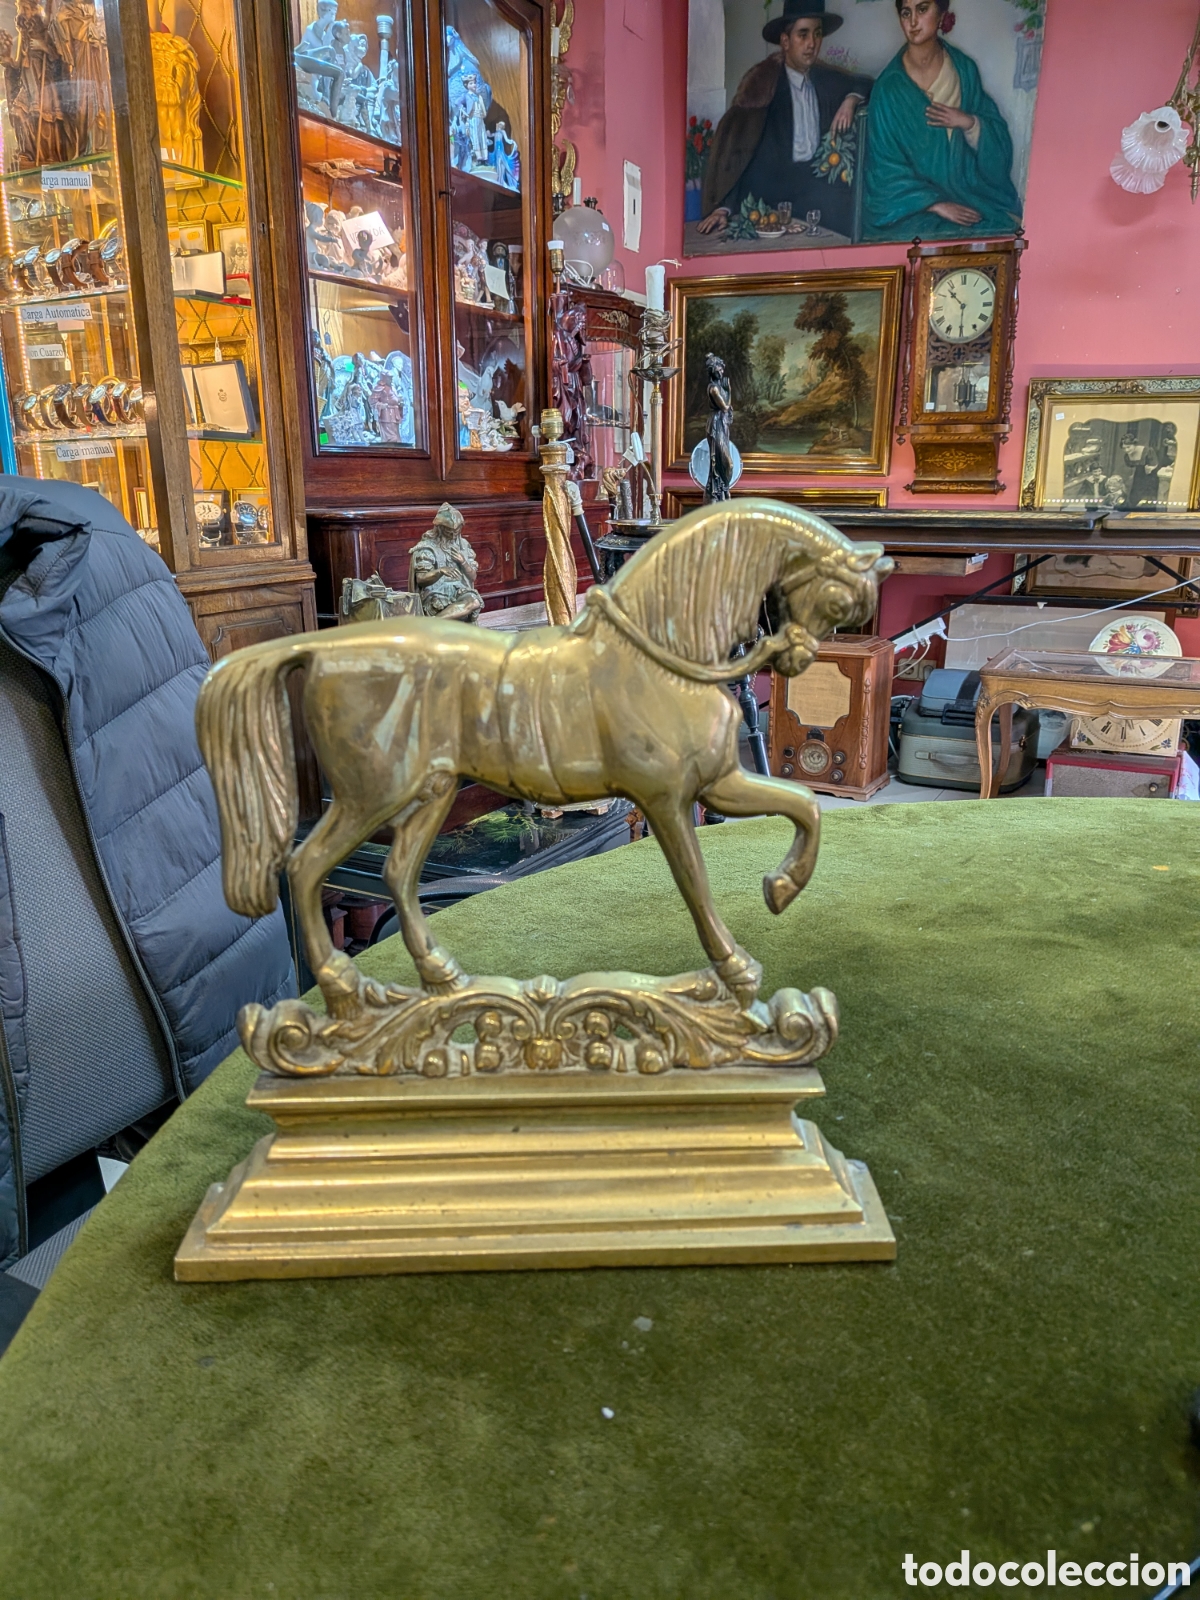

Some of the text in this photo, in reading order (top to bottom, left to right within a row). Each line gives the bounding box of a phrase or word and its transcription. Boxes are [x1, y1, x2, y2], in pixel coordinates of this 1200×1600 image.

[60, 175, 91, 187] manual
[21, 305, 91, 322] Carga Automatica
[56, 442, 113, 459] Carga manual
